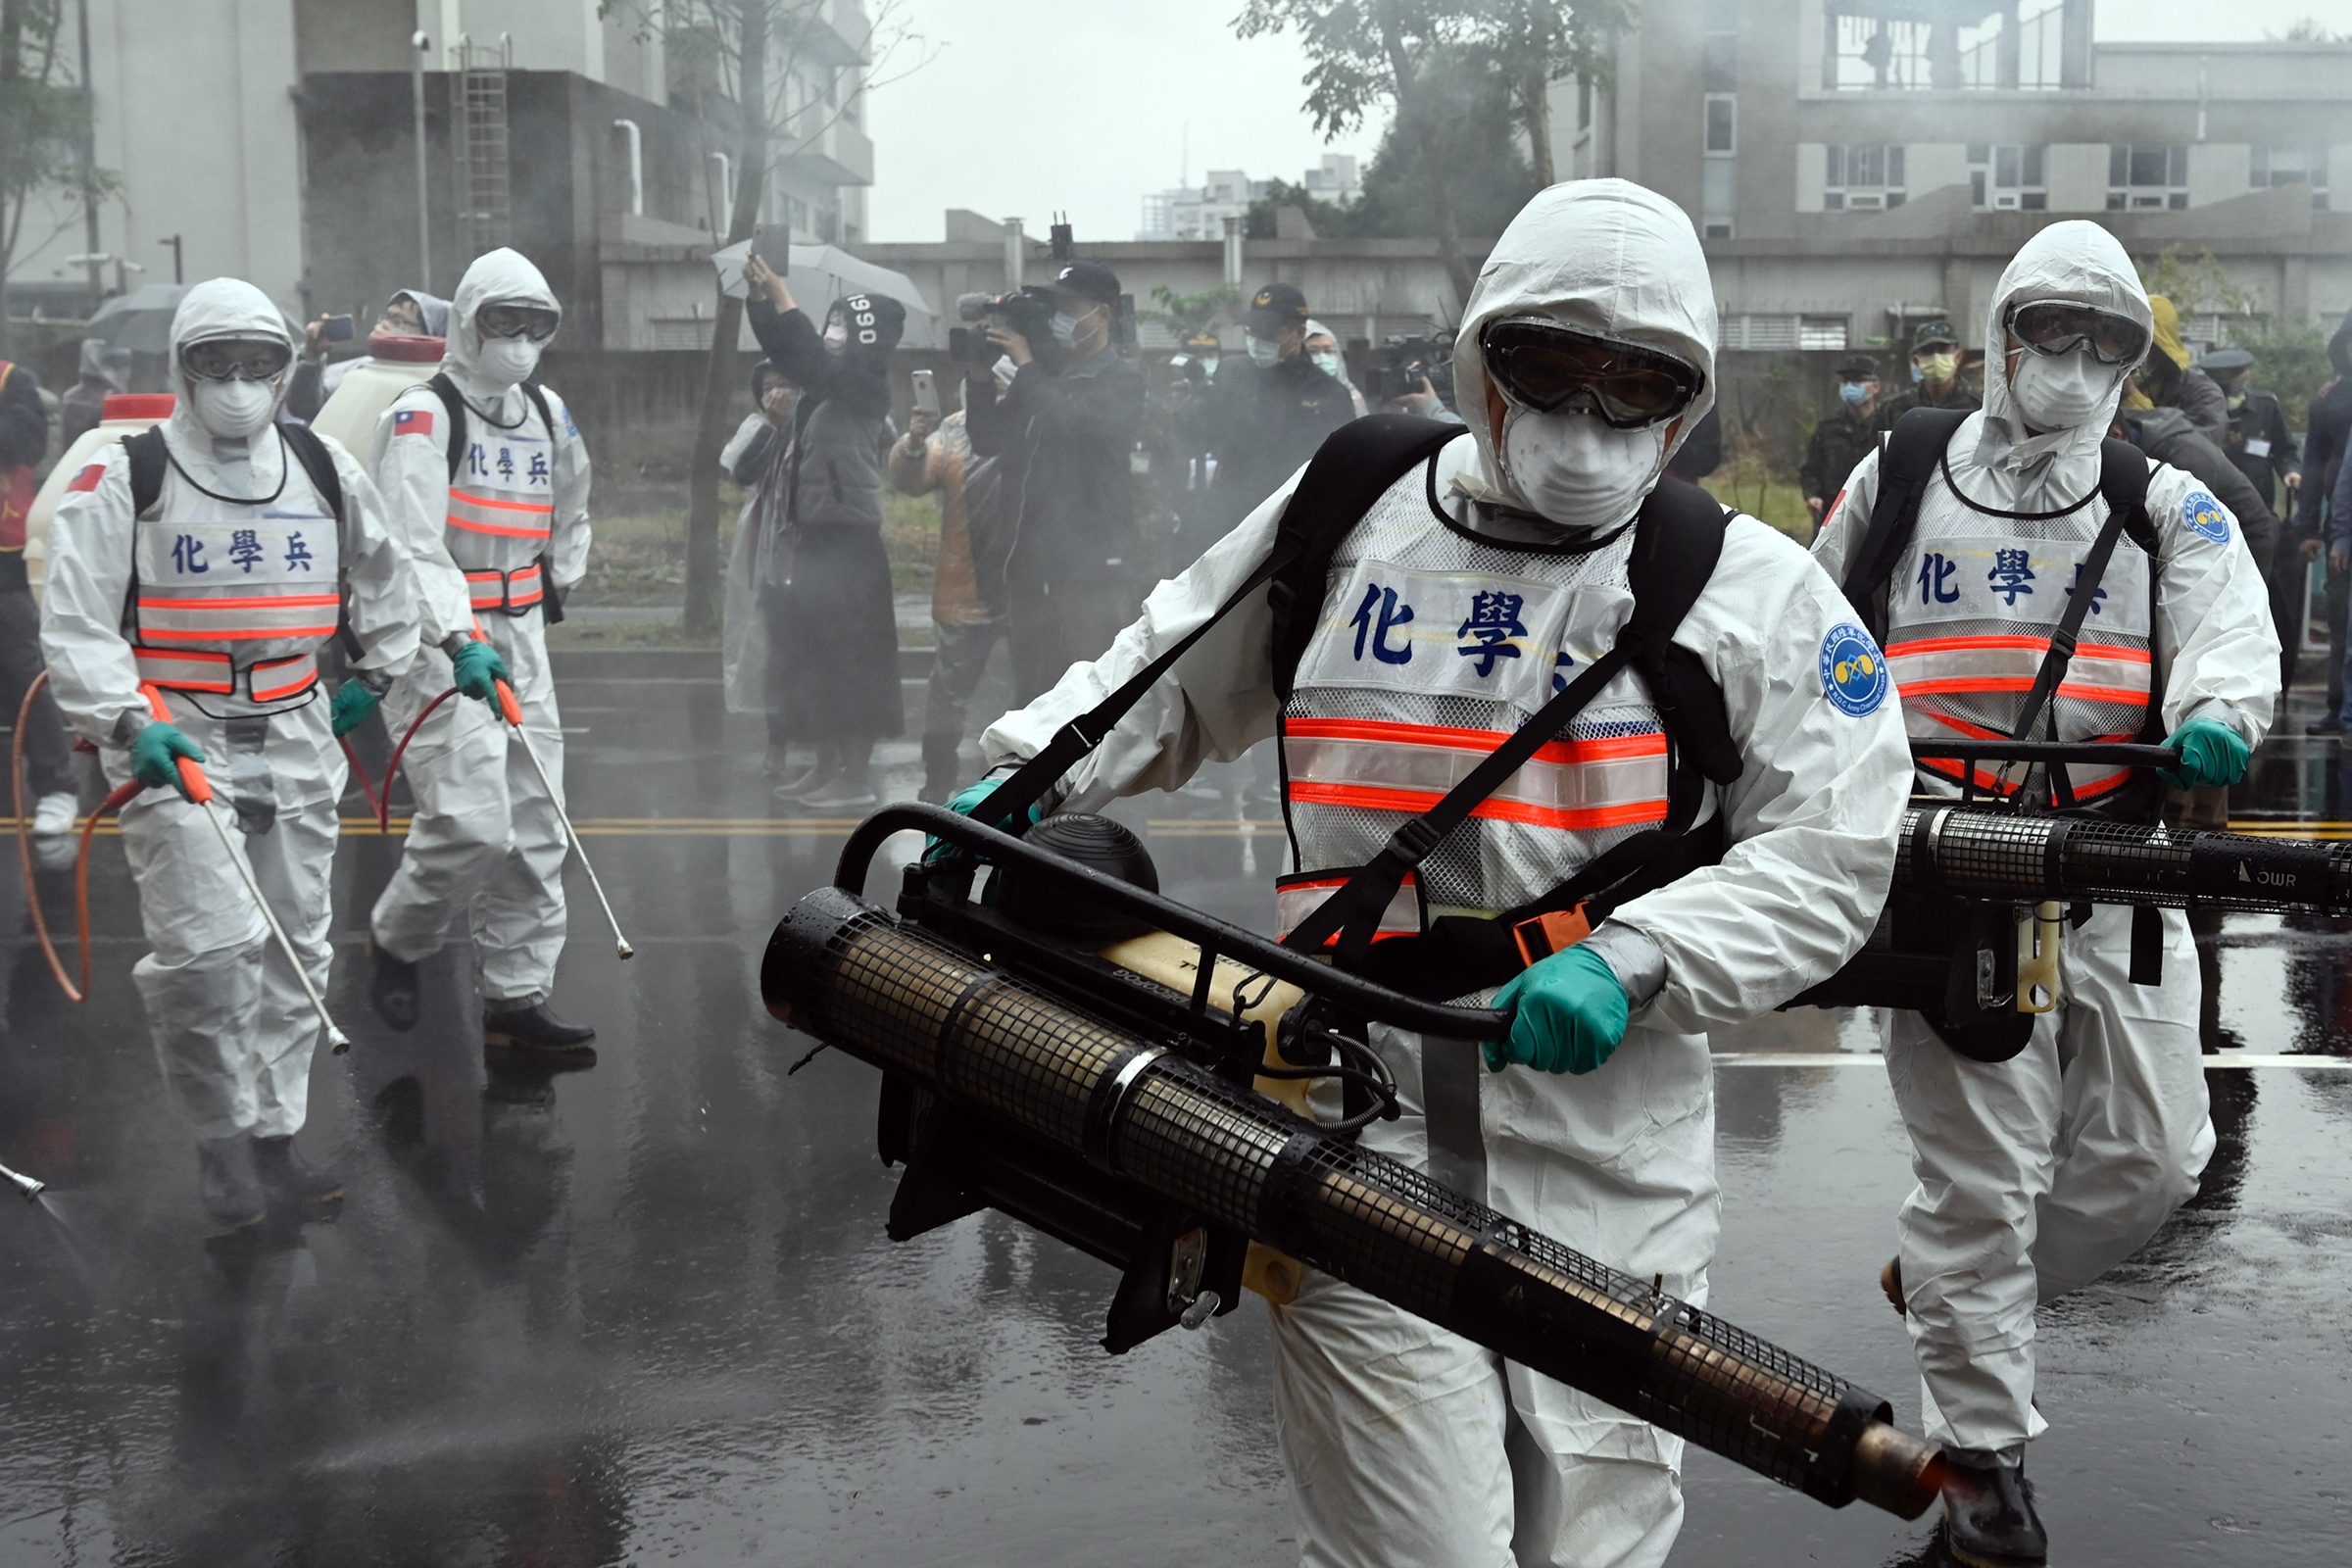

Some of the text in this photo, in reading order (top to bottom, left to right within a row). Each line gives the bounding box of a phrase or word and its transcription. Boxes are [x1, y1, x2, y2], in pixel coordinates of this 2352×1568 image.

[466, 443, 549, 485] 化學兵
[171, 529, 313, 574] 化學兵
[1348, 582, 1574, 692] 化學
